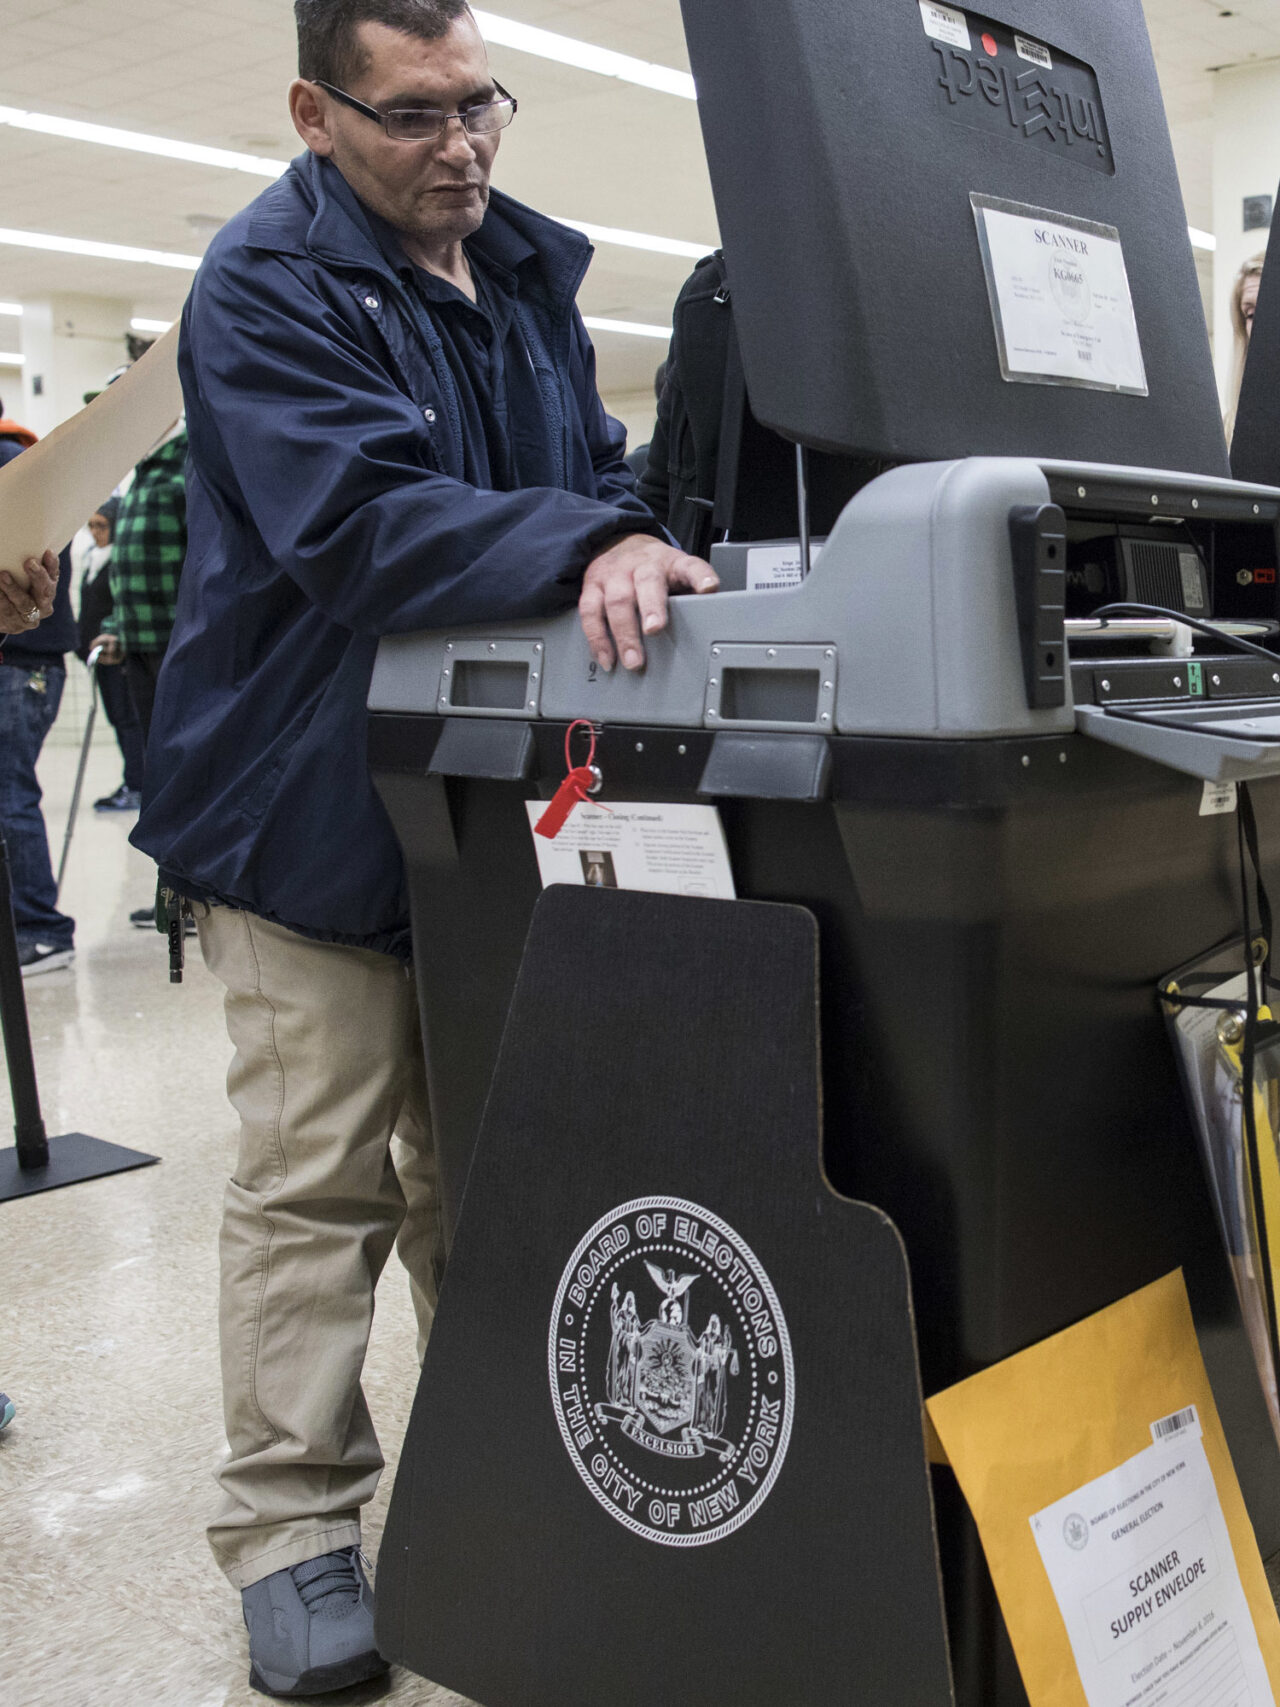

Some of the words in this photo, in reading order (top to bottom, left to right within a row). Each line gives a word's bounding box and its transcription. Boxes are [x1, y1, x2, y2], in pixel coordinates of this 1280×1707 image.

[1033, 228, 1089, 256] SCANNER
[569, 1224, 630, 1308] BOARD
[636, 1214, 667, 1240] OF
[673, 1215, 778, 1359] ELECTIONS
[558, 1338, 577, 1371] IN
[563, 1383, 594, 1450] THE
[738, 1394, 781, 1484] YORK
[630, 1426, 695, 1456] EXCELSIOR
[591, 1452, 643, 1512] CITY
[690, 1480, 739, 1527] NEW
[648, 1502, 680, 1527] OF
[1111, 1520, 1139, 1541] GENERAL
[1139, 1501, 1164, 1524] ELECTION
[1129, 1550, 1181, 1598] SCANNER
[1110, 1597, 1153, 1639] SUPPLY
[1157, 1558, 1206, 1608] ENVELOPE
